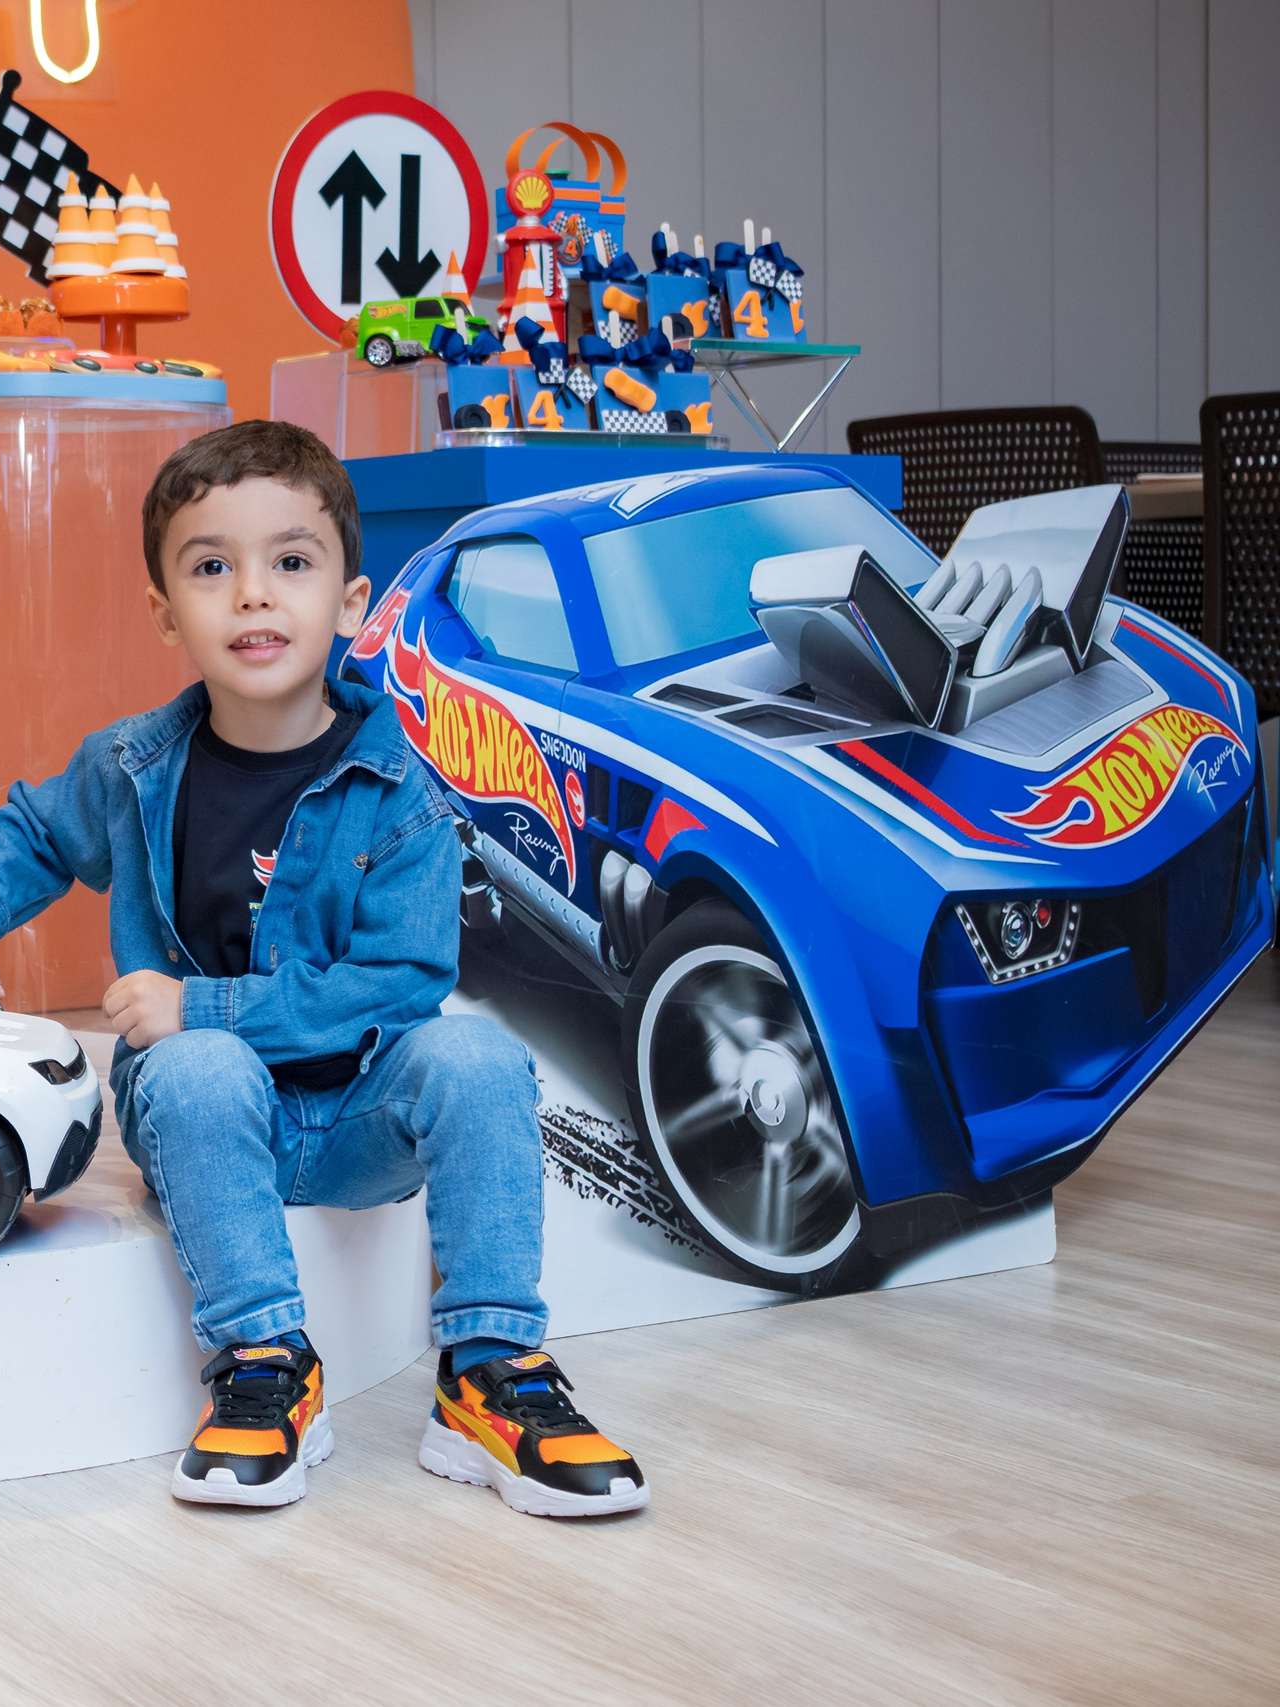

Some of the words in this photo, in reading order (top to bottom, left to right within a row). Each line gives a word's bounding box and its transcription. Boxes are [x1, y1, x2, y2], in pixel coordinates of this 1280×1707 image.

[564, 239, 578, 258] 4
[734, 291, 770, 338] 4
[527, 390, 564, 431] 4
